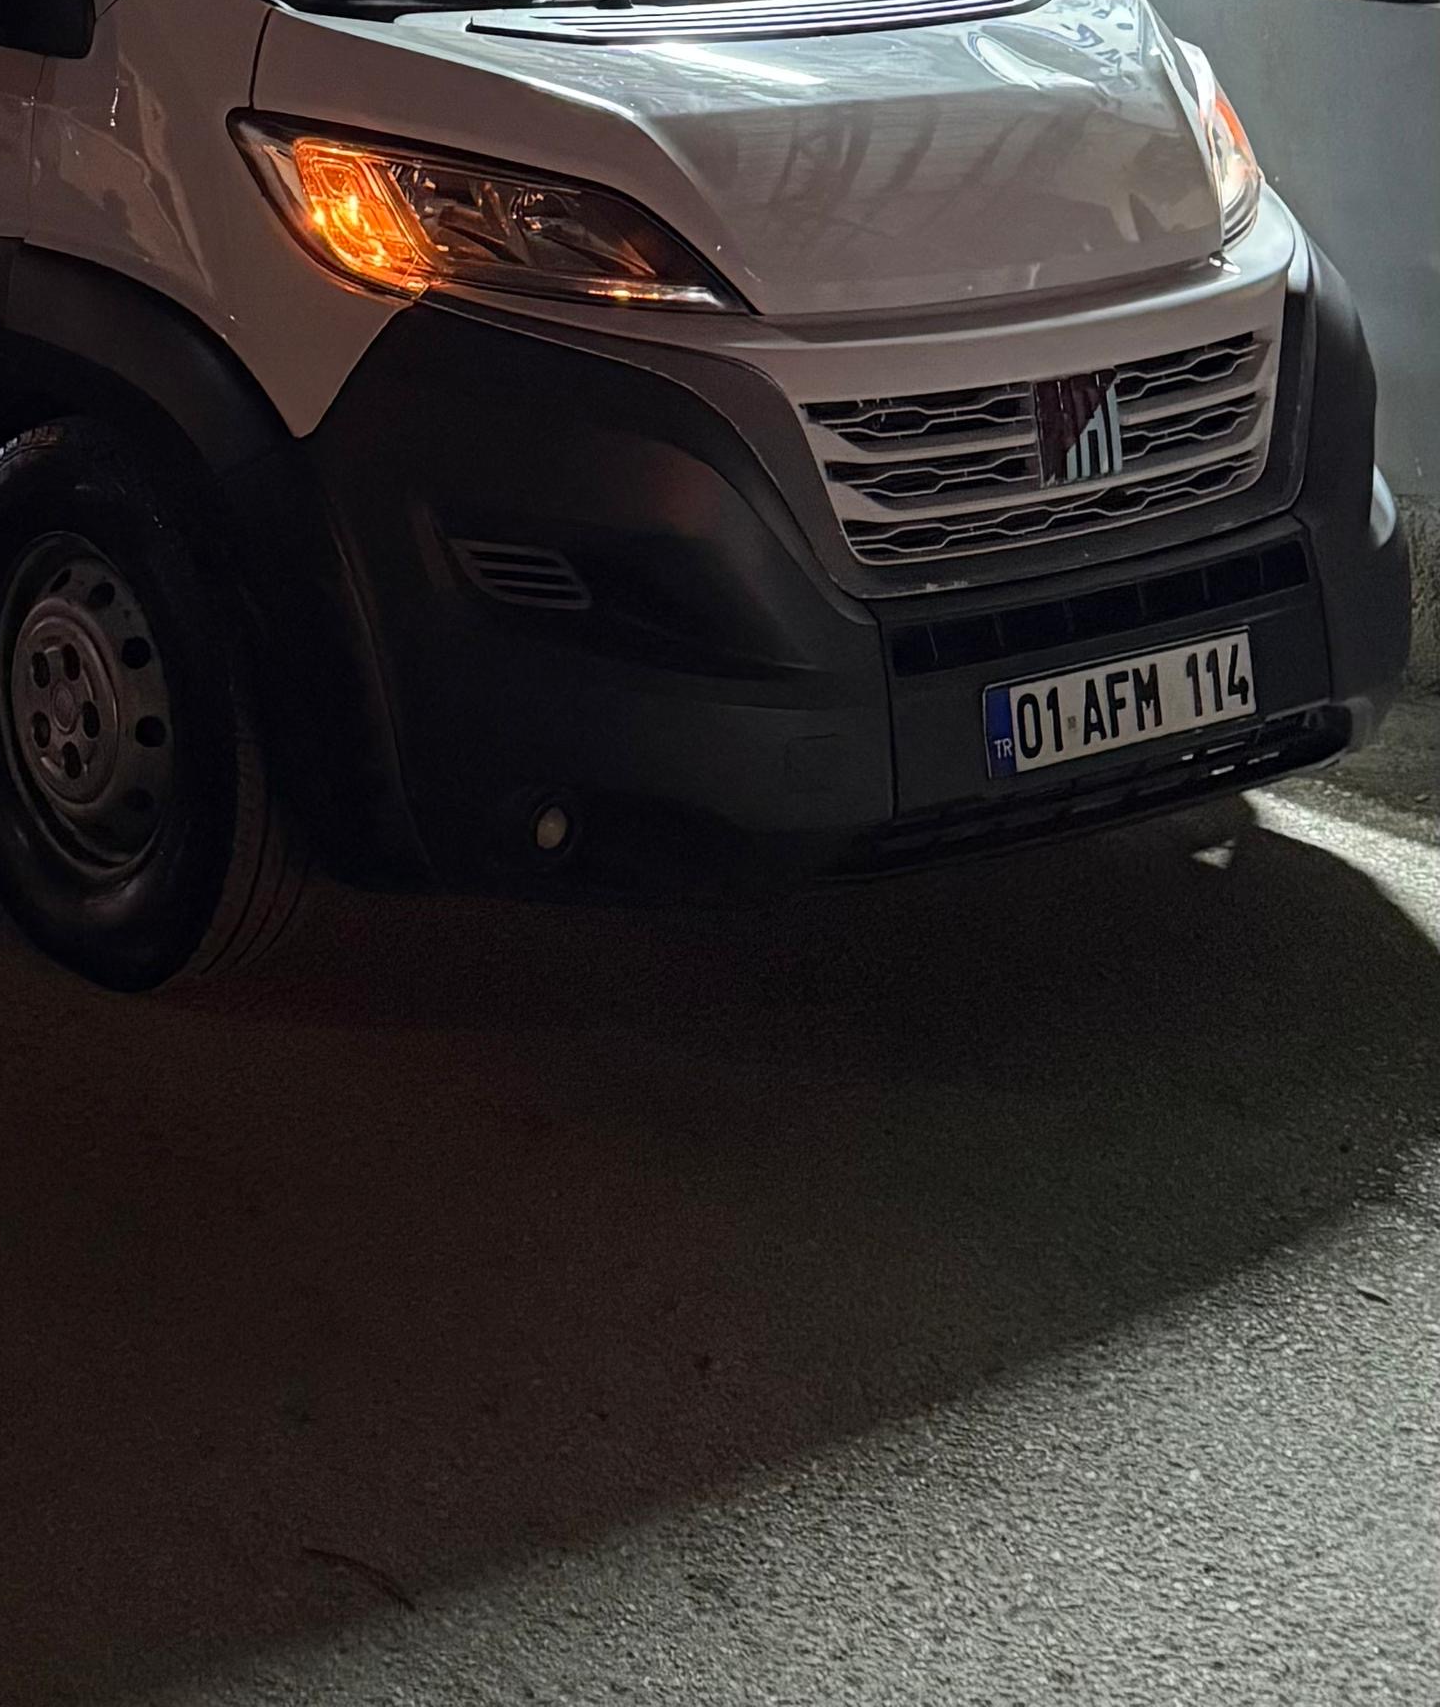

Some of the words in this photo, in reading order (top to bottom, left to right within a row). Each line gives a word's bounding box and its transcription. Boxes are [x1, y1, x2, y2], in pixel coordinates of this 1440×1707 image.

[1016, 686, 1064, 759] 01
[1083, 663, 1163, 745] AFM
[1185, 643, 1250, 717] 114
[994, 738, 1013, 759] TR
